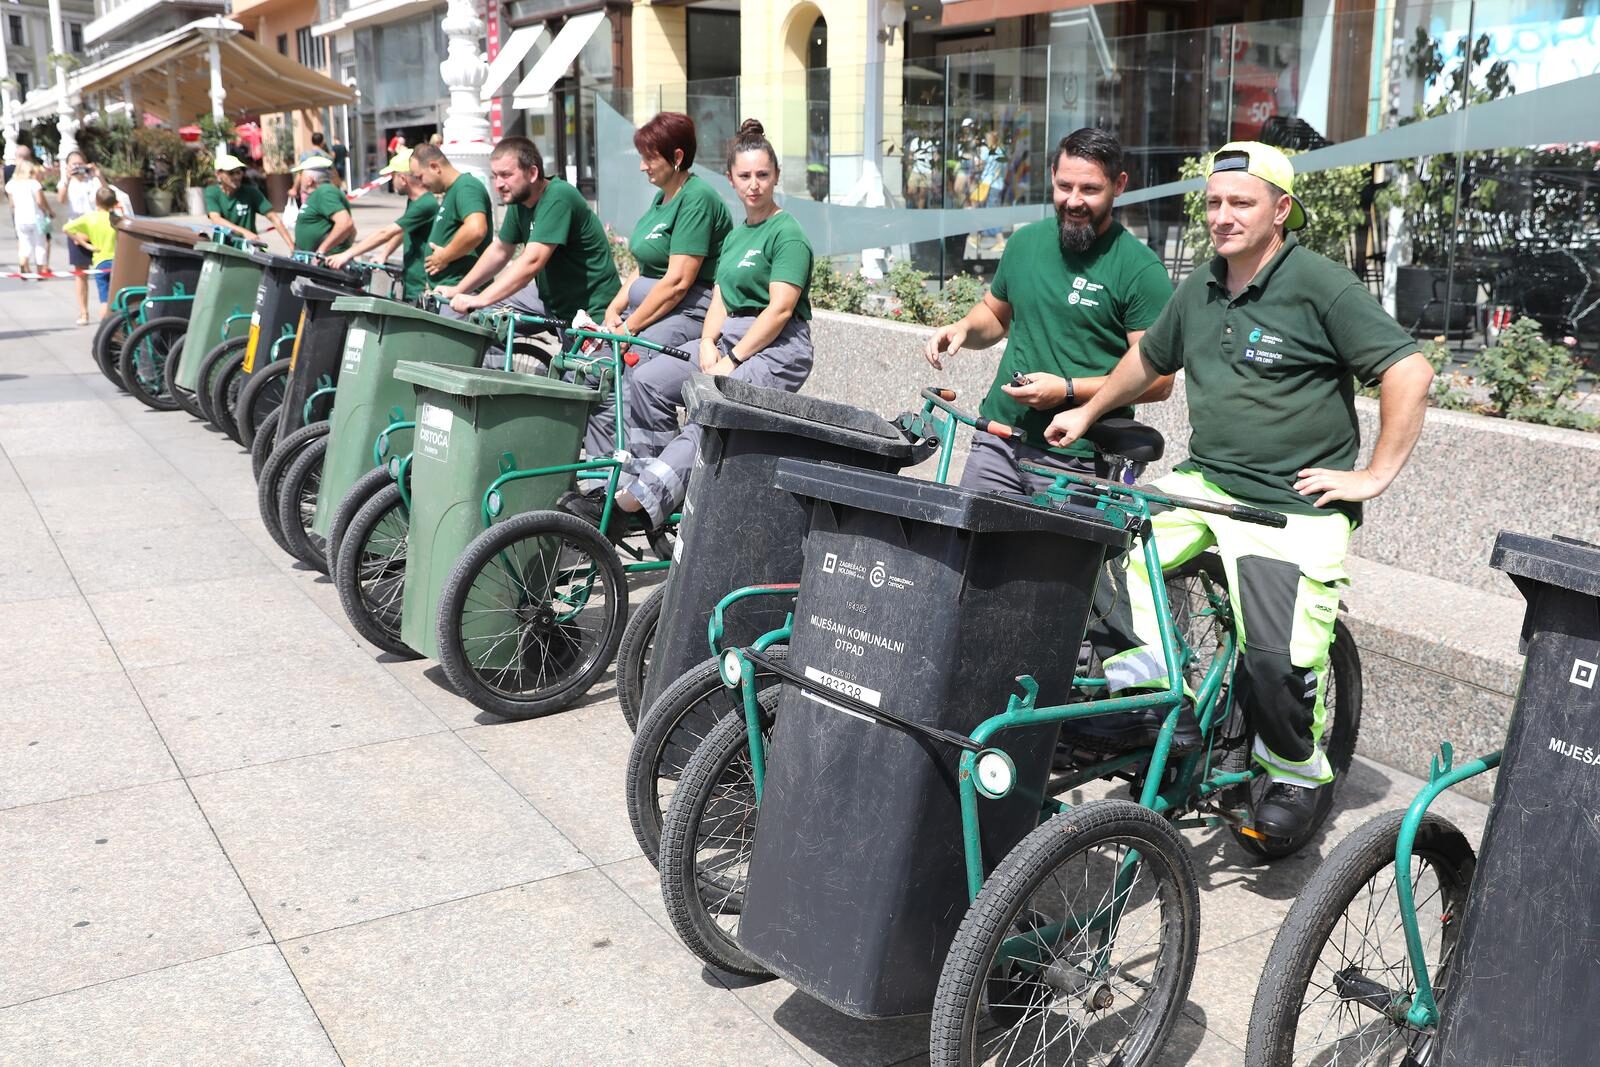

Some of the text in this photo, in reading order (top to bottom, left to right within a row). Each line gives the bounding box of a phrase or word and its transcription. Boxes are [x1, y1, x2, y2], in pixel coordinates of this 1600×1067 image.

[838, 567, 857, 578] HOLDING
[810, 614, 905, 654] MIJEŠANI KOMUNALNI
[834, 639, 865, 657] OTPAD
